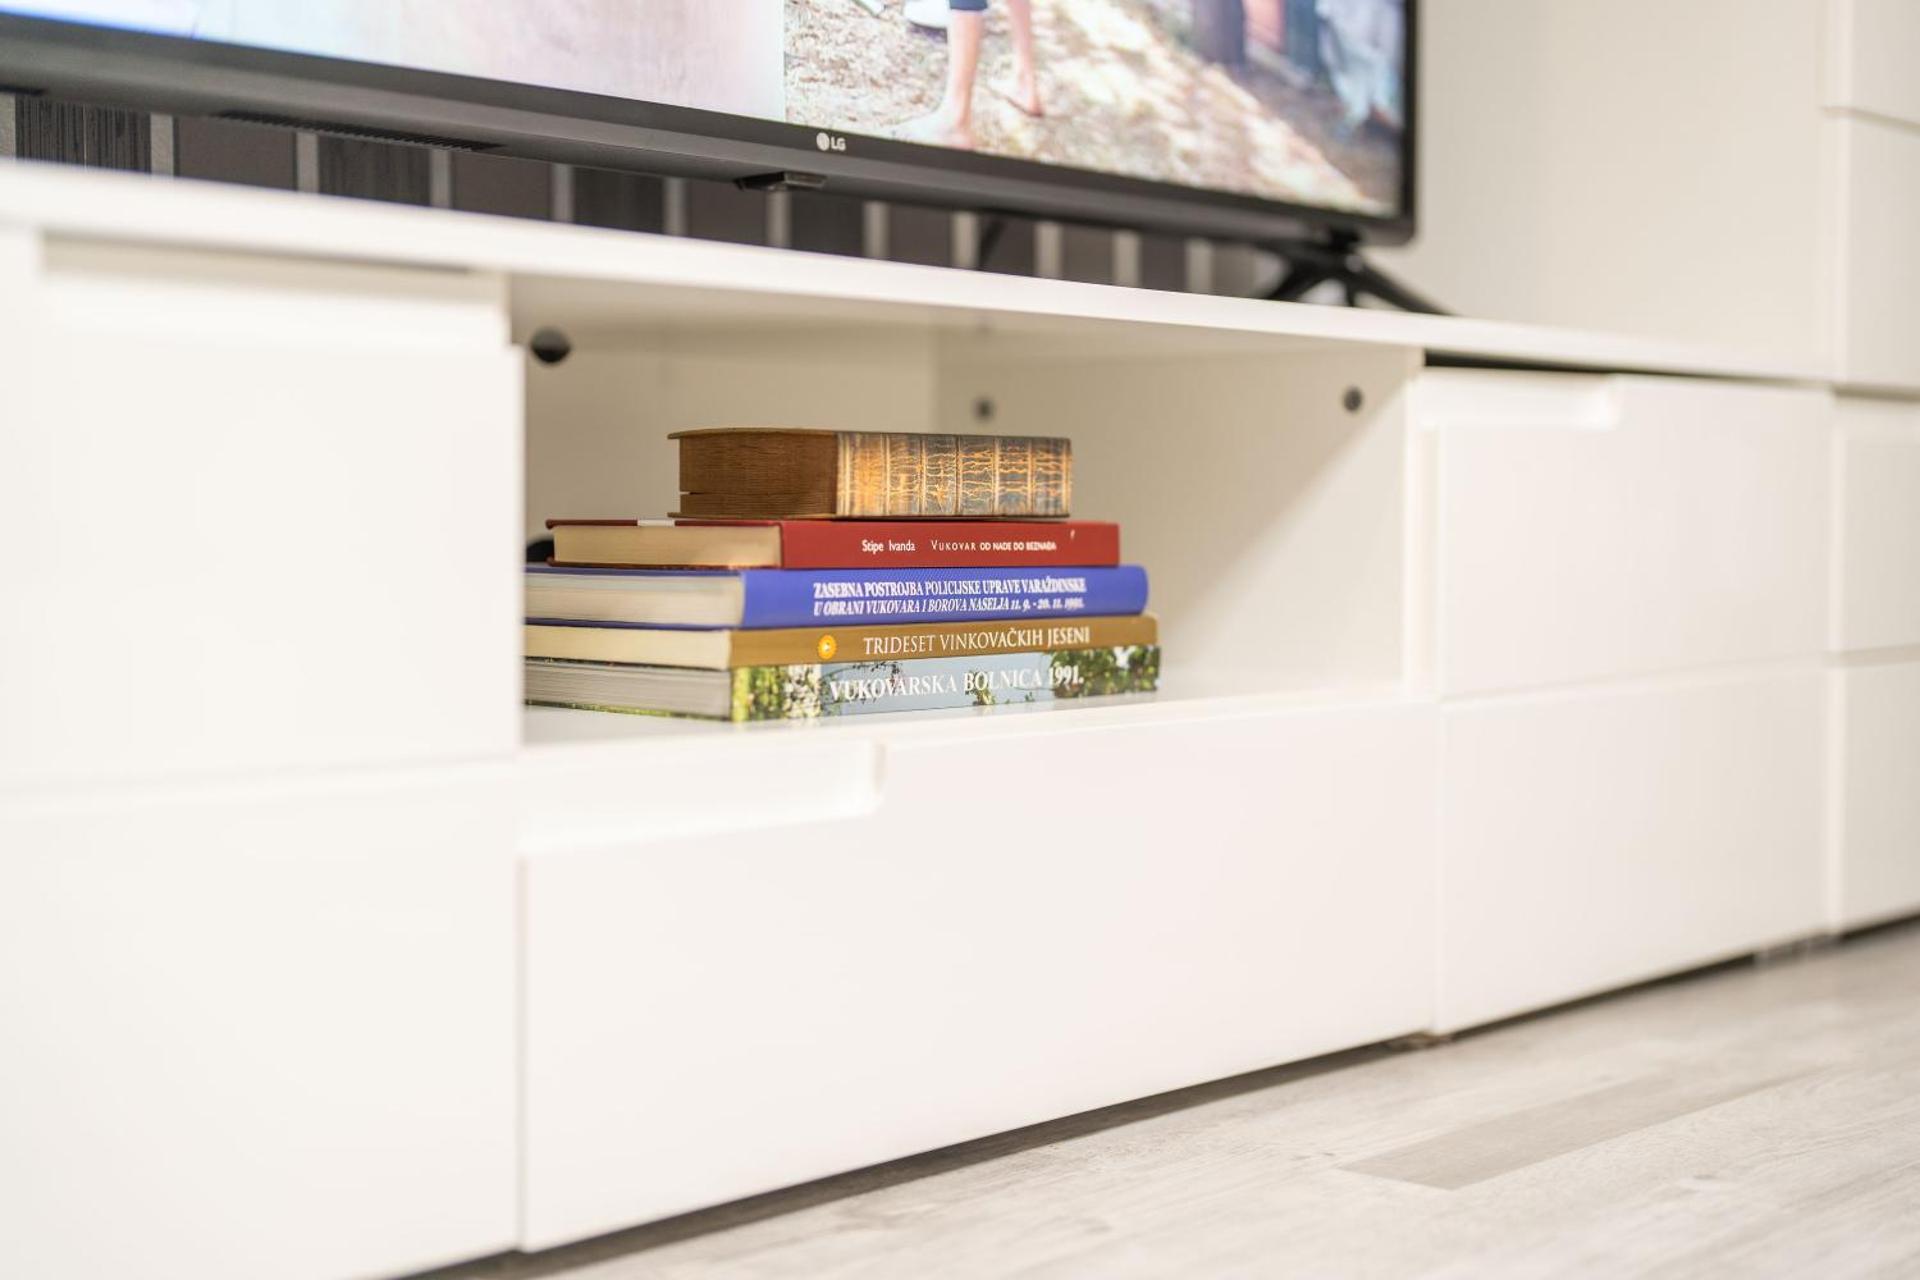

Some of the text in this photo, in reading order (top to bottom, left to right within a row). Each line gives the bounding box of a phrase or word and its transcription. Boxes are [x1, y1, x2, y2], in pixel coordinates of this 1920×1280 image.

[862, 539, 916, 555] Stipe Ivanda
[931, 539, 976, 551] VUKOVAR
[980, 542, 992, 551] OD
[993, 541, 1012, 551] NADE
[1013, 541, 1025, 551] DO
[813, 575, 1087, 599] ZASEBNA POSTROJBA POLICIJSKE UPRAVE VARAŽDINSKE
[813, 601, 823, 616] U
[823, 600, 864, 616] OBRANI
[865, 600, 920, 614] VUKOVARA
[921, 600, 927, 613] I
[928, 598, 967, 612] BOROVA
[968, 597, 1009, 611] NASELJA
[863, 626, 1091, 655] TRIDESET VINKOVAČKIH JESENI
[829, 664, 1084, 701] VUKOVARSKA BOLNICA 1991.
